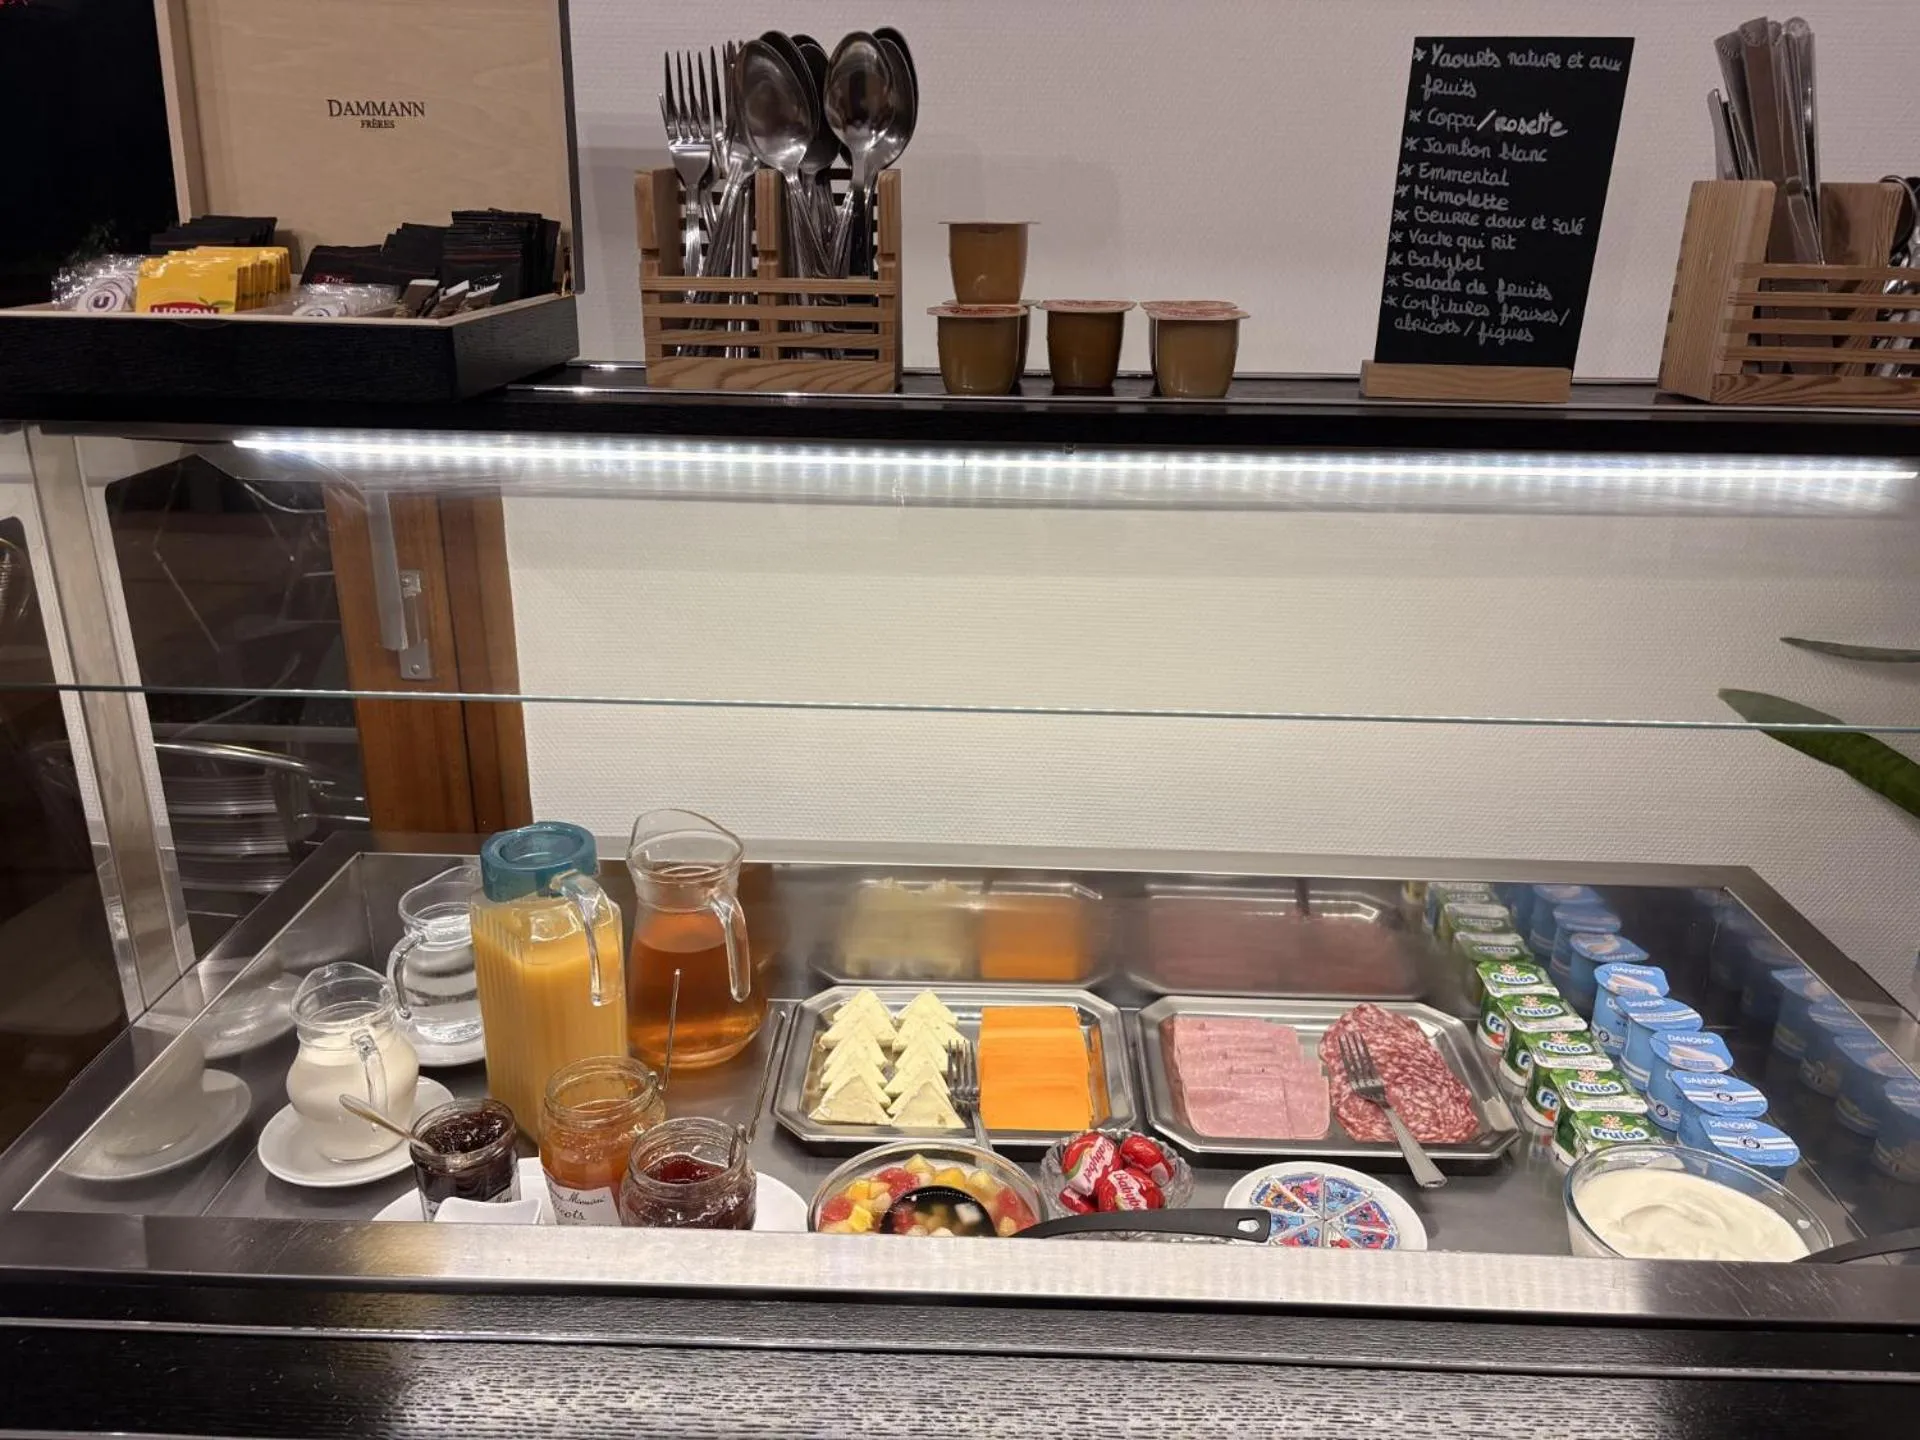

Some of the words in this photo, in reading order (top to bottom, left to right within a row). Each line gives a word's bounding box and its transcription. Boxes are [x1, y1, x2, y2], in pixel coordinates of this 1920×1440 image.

[1430, 43, 1501, 68] Yaourts
[1507, 48, 1561, 69] nature
[1567, 51, 1584, 69] et
[1589, 55, 1623, 72] aux
[1421, 72, 1477, 101] fruits
[326, 99, 425, 118] DAMMANN
[1422, 136, 1491, 159] Jambon
[1499, 141, 1548, 162] blanc
[1419, 162, 1510, 186] Emmental
[1414, 184, 1510, 211] Mimolette
[1414, 206, 1480, 227] Beurre
[1485, 212, 1526, 229] doux
[1531, 215, 1546, 231] et
[1552, 217, 1586, 236] salé
[1409, 228, 1453, 247] Vache
[1457, 232, 1486, 253] qui
[1408, 250, 1485, 278] Babybel
[1402, 272, 1462, 293] Salade
[1466, 279, 1489, 296] de
[1496, 278, 1553, 304] fruits
[1401, 294, 1490, 320] Confitures
